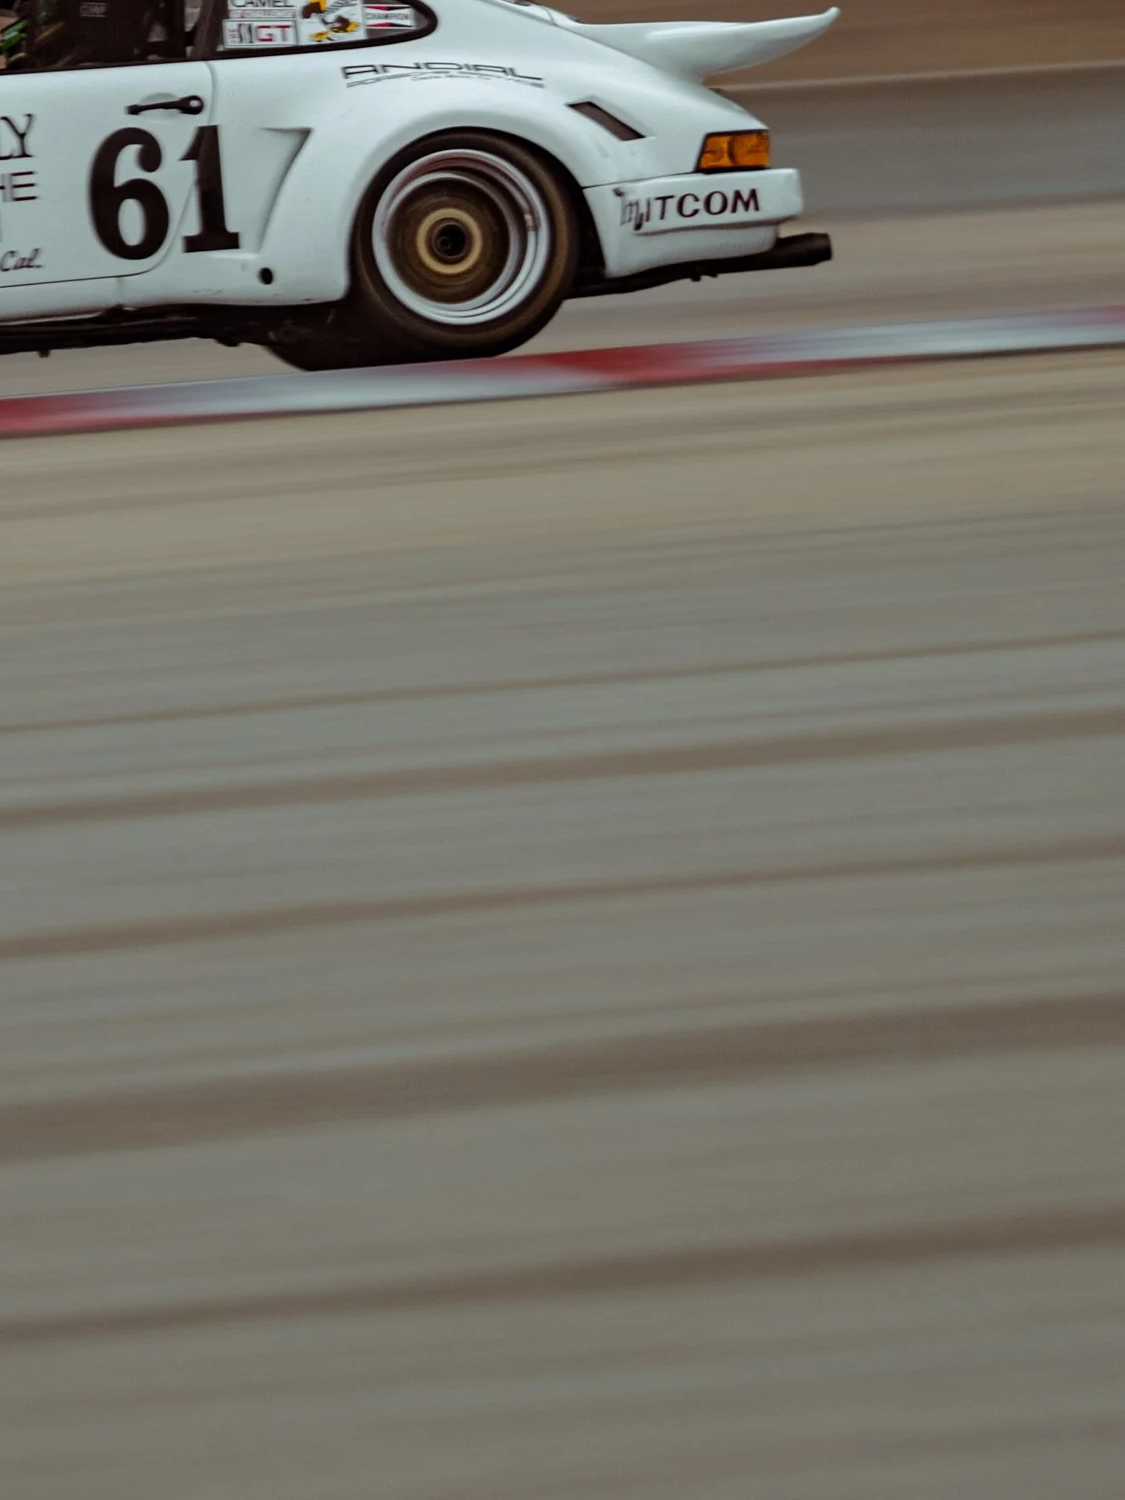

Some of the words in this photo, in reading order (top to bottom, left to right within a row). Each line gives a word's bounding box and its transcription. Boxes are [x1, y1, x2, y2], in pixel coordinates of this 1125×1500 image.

[256, 24, 293, 42] GT
[341, 62, 544, 81] ANDIAL
[89, 125, 241, 260] 61
